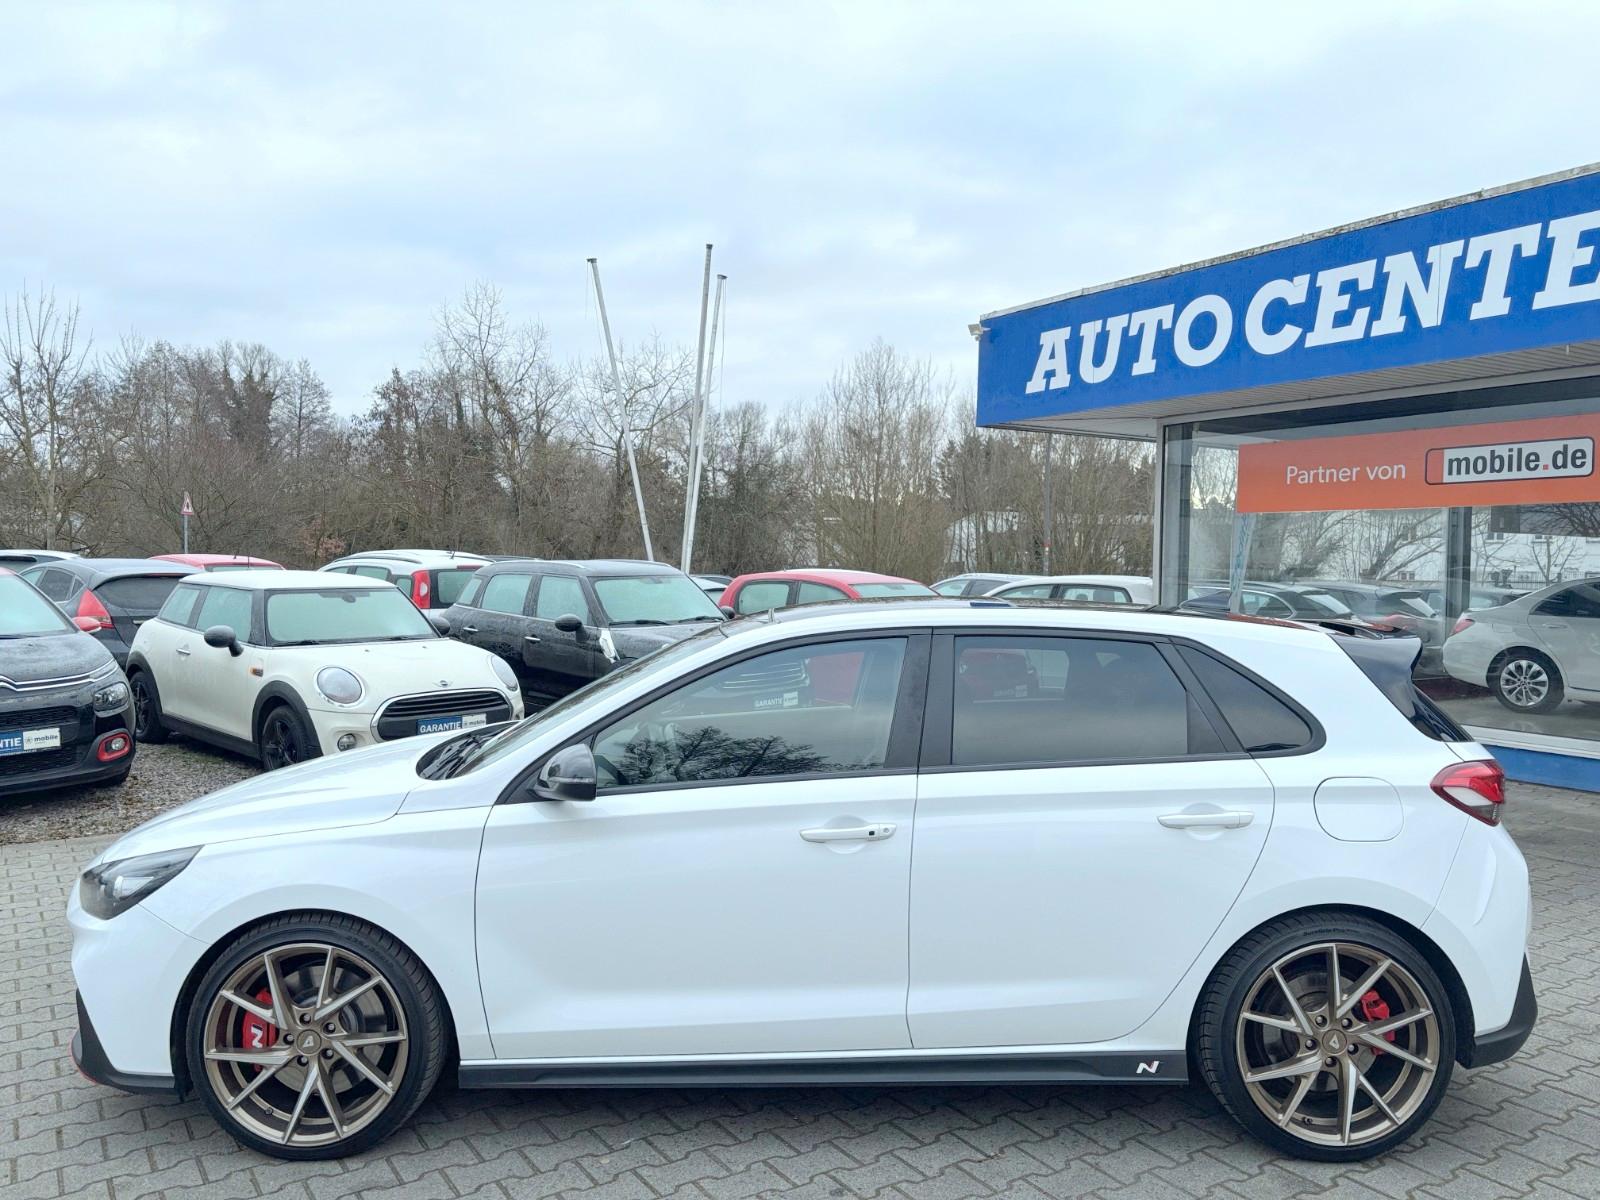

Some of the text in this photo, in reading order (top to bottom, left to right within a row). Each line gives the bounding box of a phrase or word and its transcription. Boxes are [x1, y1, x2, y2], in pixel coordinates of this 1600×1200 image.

[1286, 444, 1587, 485] Partner von mobile.de
[420, 721, 461, 733] GARANTIE
[1136, 1061, 1160, 1074] N
